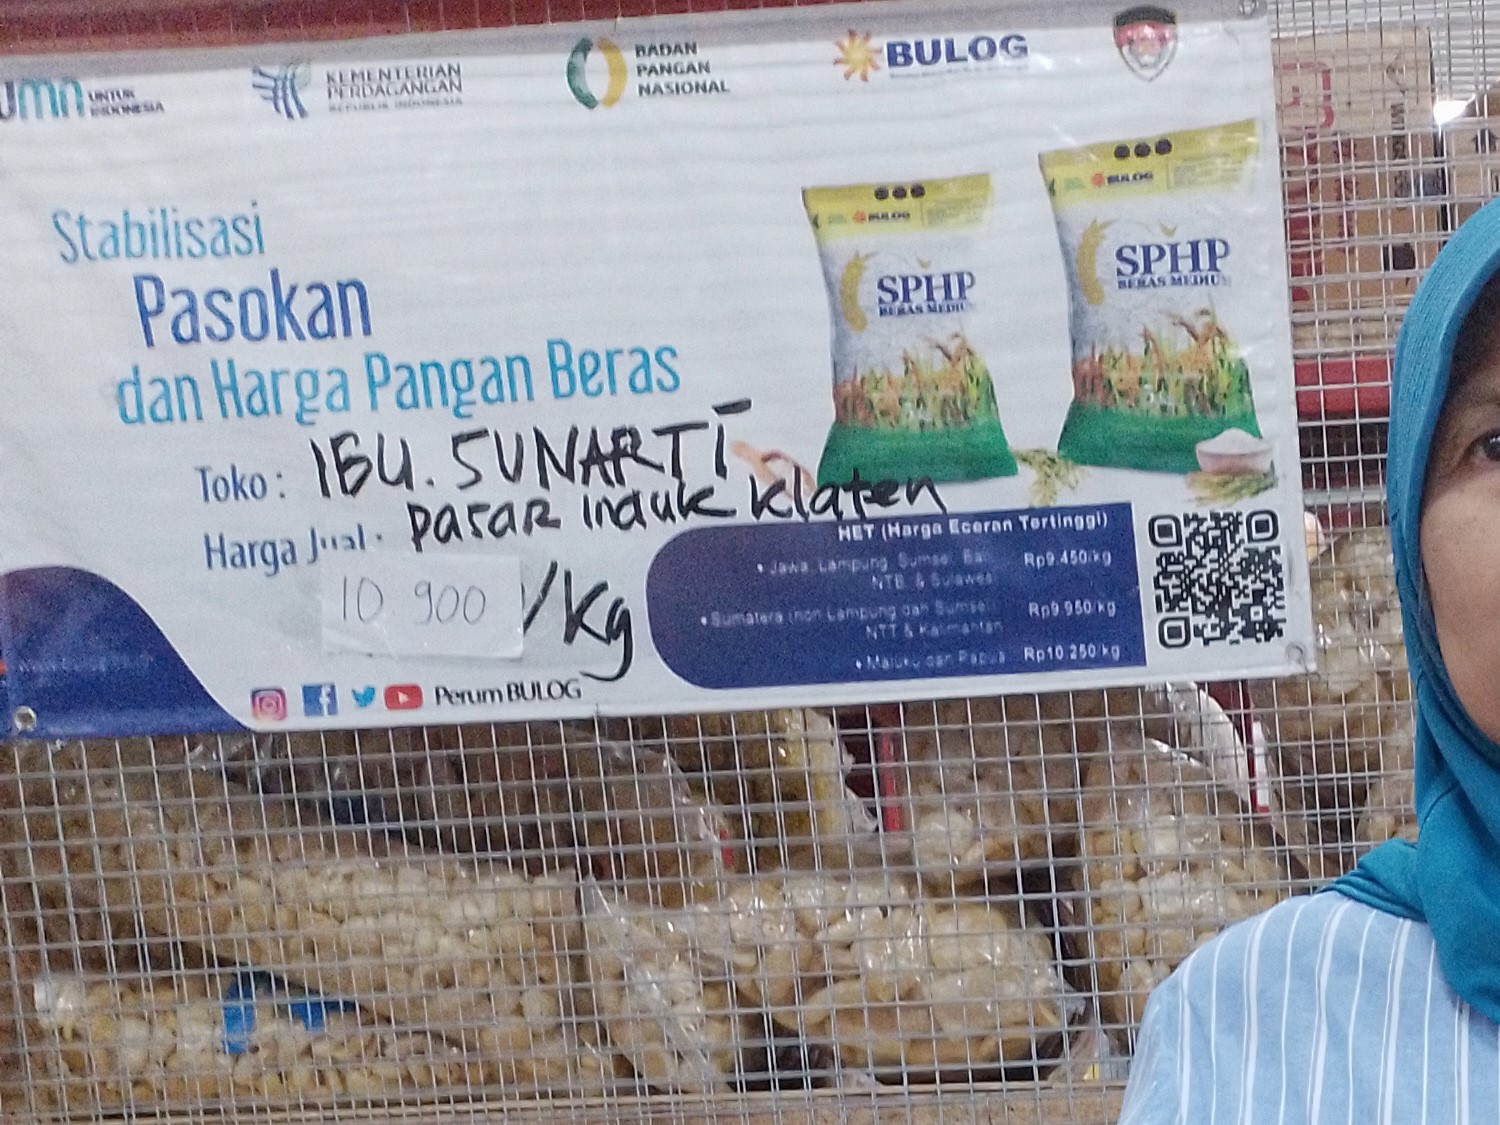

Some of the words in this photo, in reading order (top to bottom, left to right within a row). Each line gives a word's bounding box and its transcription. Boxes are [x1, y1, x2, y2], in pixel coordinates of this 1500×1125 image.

[635, 41, 698, 58] BADAN
[885, 33, 1029, 68] BULOG
[326, 62, 463, 85] KEMENTERIAN
[636, 60, 711, 78] PANGAN
[327, 78, 463, 100] PERDAGANGAN
[637, 79, 730, 97] NASIONAL
[52, 201, 266, 263] Stabilisasi
[1115, 238, 1231, 277] SPHP
[877, 271, 976, 305] SPHP
[133, 268, 373, 348] Pasokan
[927, 301, 973, 315] MEDIU
[117, 366, 204, 426] dan
[210, 358, 350, 427] Harga
[365, 350, 535, 421] Pangan
[547, 338, 681, 398] Beras
[837, 524, 875, 541] HET
[203, 532, 297, 577] Harga
[434, 683, 503, 706] Perum
[507, 679, 582, 703] BULOG
